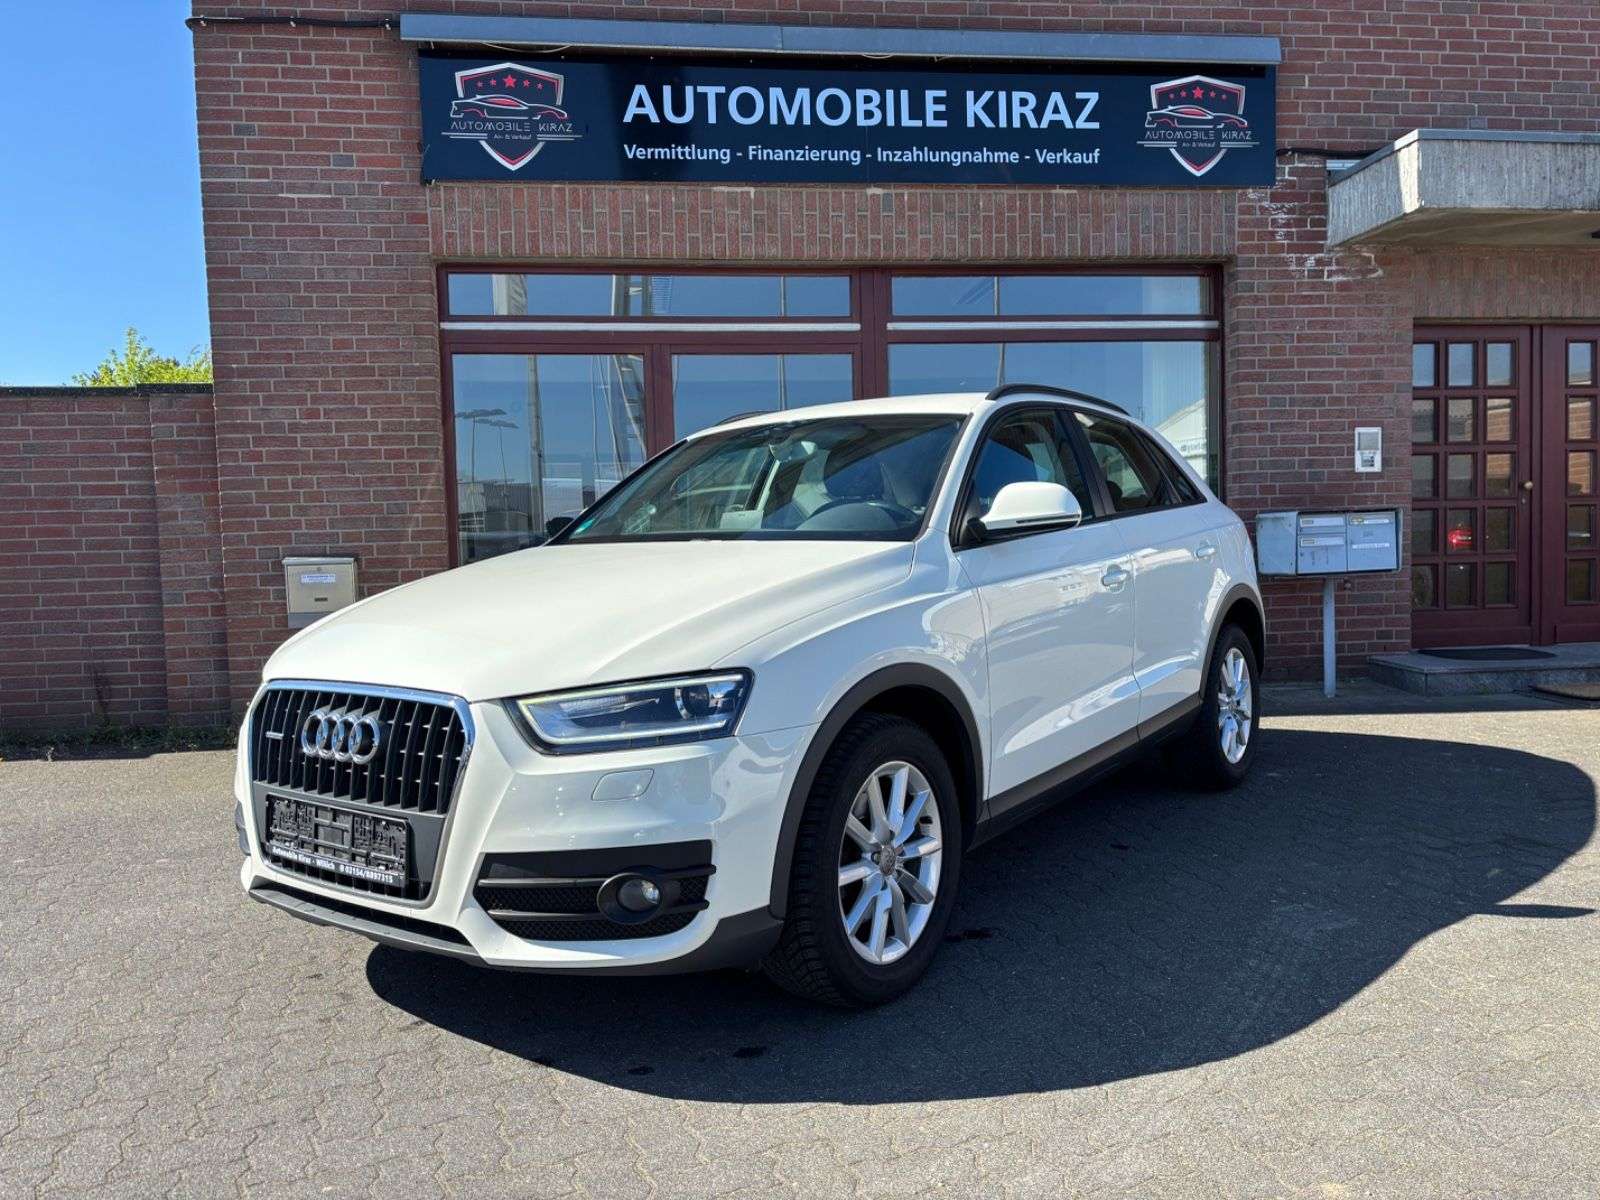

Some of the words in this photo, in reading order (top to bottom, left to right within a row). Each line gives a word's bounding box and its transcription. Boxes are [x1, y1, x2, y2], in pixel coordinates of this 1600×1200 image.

[623, 84, 948, 128] AUTOMOBILE
[966, 90, 1100, 129] KIRAZ
[450, 121, 531, 132] AUTOMOBILE
[538, 122, 573, 132] KIRAZ
[1144, 130, 1216, 140] AUTOMOBILE
[1222, 130, 1252, 140] KIRAZ
[623, 143, 731, 165] Vermittlung
[748, 145, 861, 166] Finanzierung
[877, 146, 1020, 167] Inzahlungnahme
[1035, 148, 1100, 164] Verkauf
